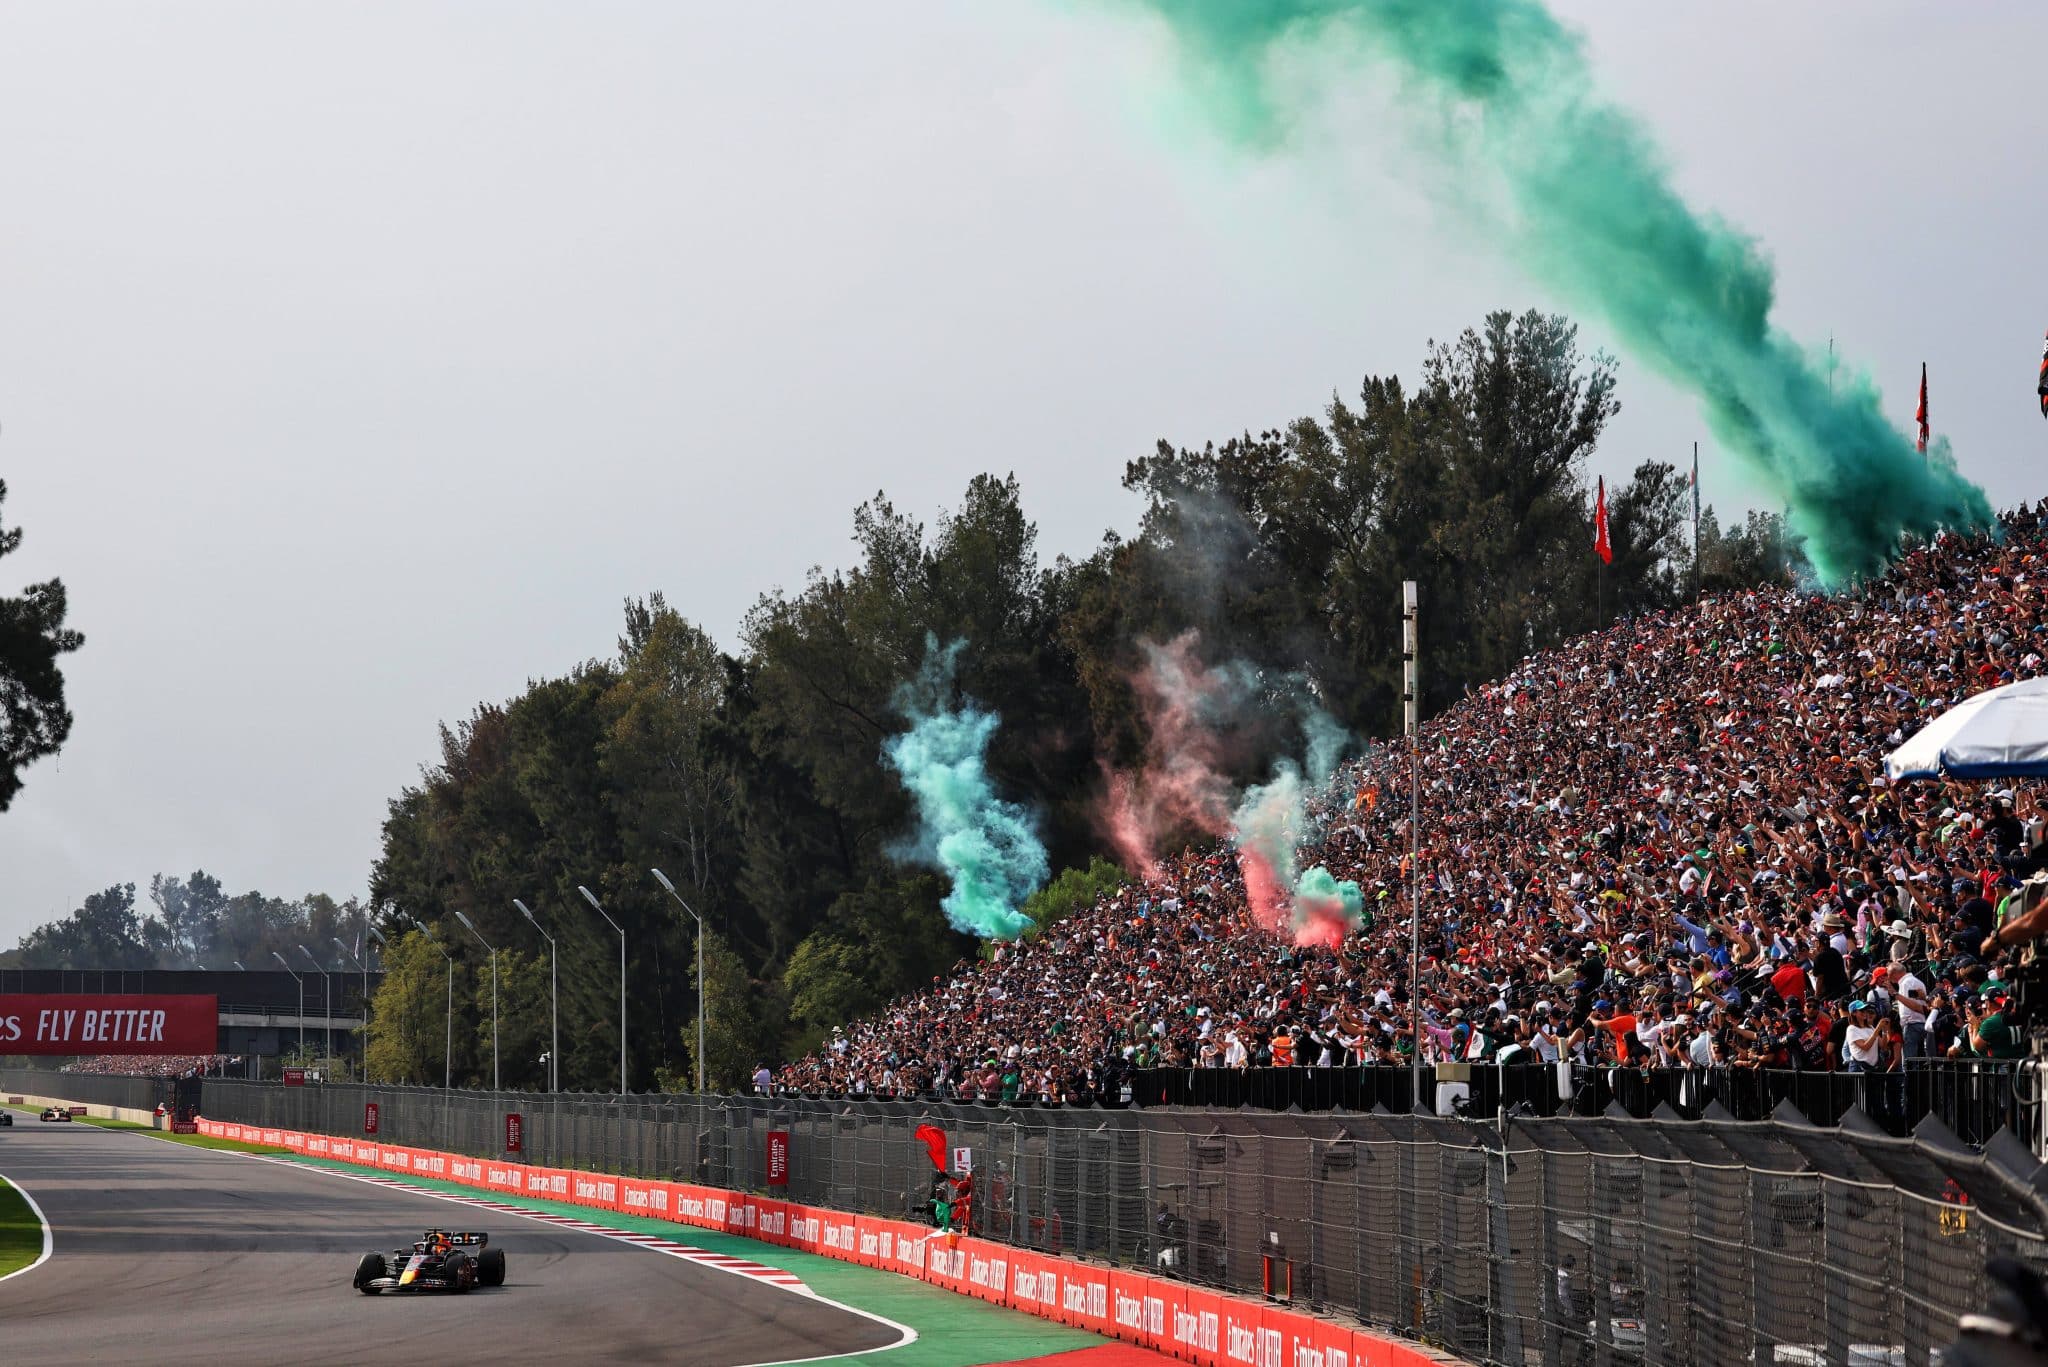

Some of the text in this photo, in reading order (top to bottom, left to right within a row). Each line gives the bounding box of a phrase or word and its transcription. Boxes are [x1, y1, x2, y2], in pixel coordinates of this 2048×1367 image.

[0, 1010, 166, 1041] s FLY BETTER
[770, 1138, 779, 1178] Emirates
[625, 1186, 648, 1207] Emirates
[678, 1194, 704, 1218] Emirates
[1063, 1276, 1086, 1314] Emirates
[1115, 1288, 1142, 1330] Emirates
[1173, 1303, 1198, 1347] Emirates
[1227, 1316, 1254, 1365] Emirates
